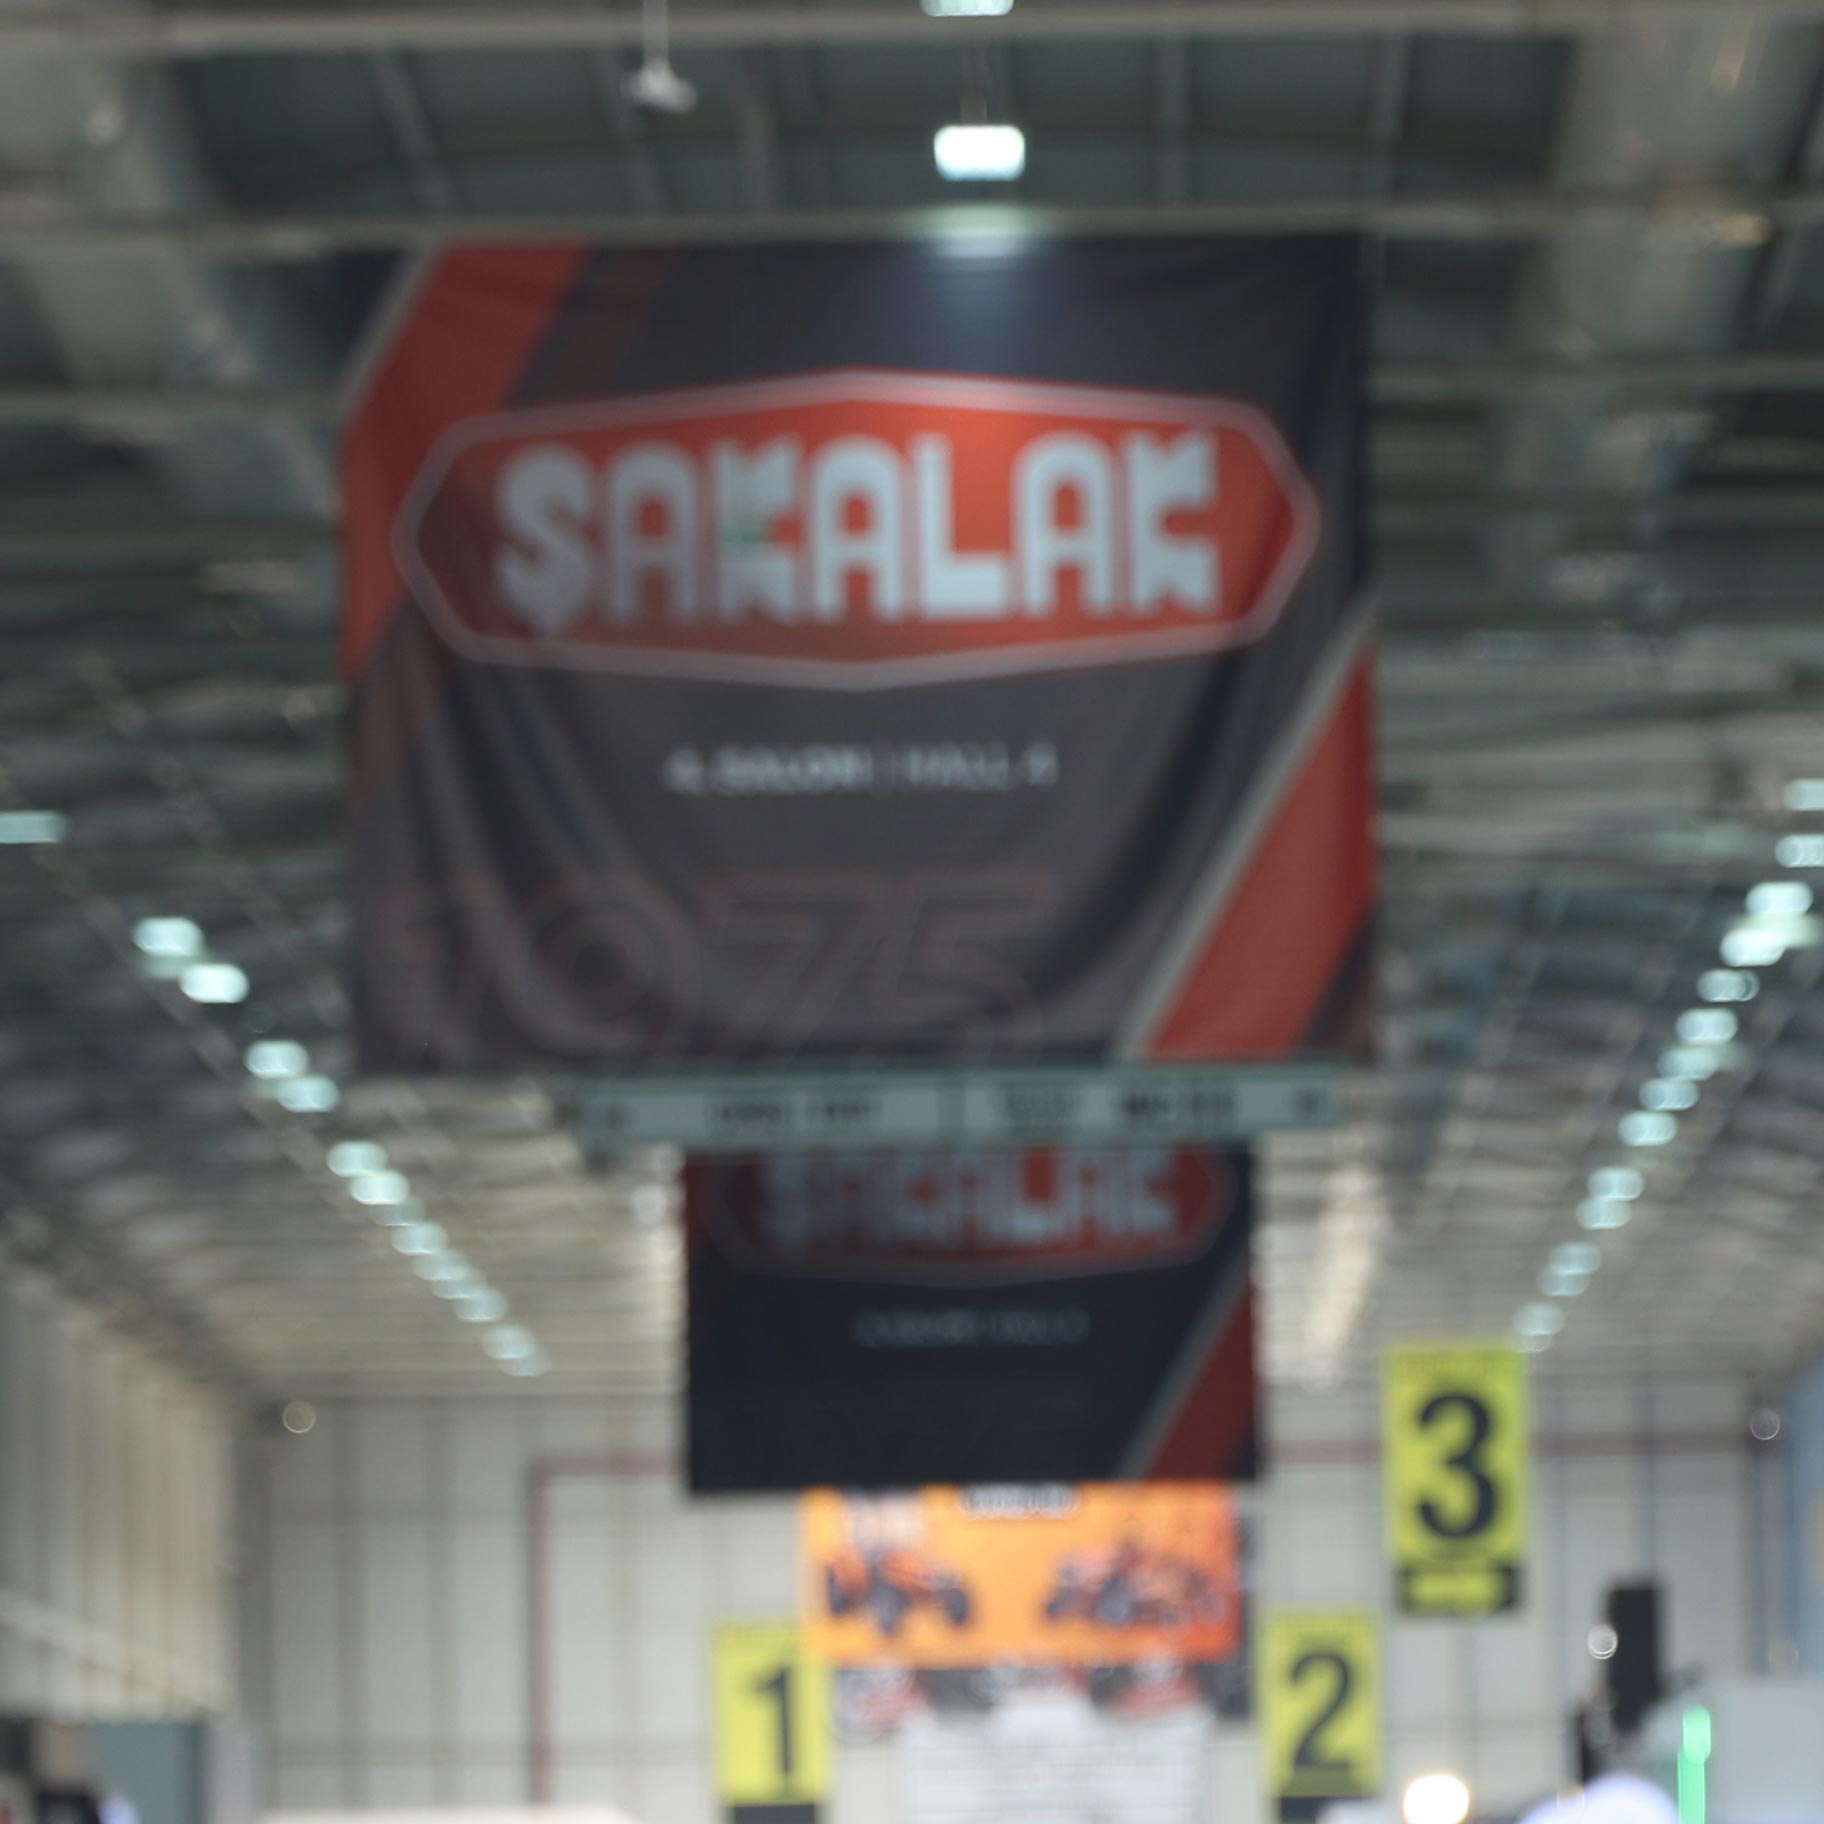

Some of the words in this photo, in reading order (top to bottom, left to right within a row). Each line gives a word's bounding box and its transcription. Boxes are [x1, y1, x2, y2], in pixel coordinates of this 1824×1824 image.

[1416, 1388, 1500, 1540] 3
[754, 1658, 800, 1786] 1
[1288, 1650, 1356, 1774] 2
